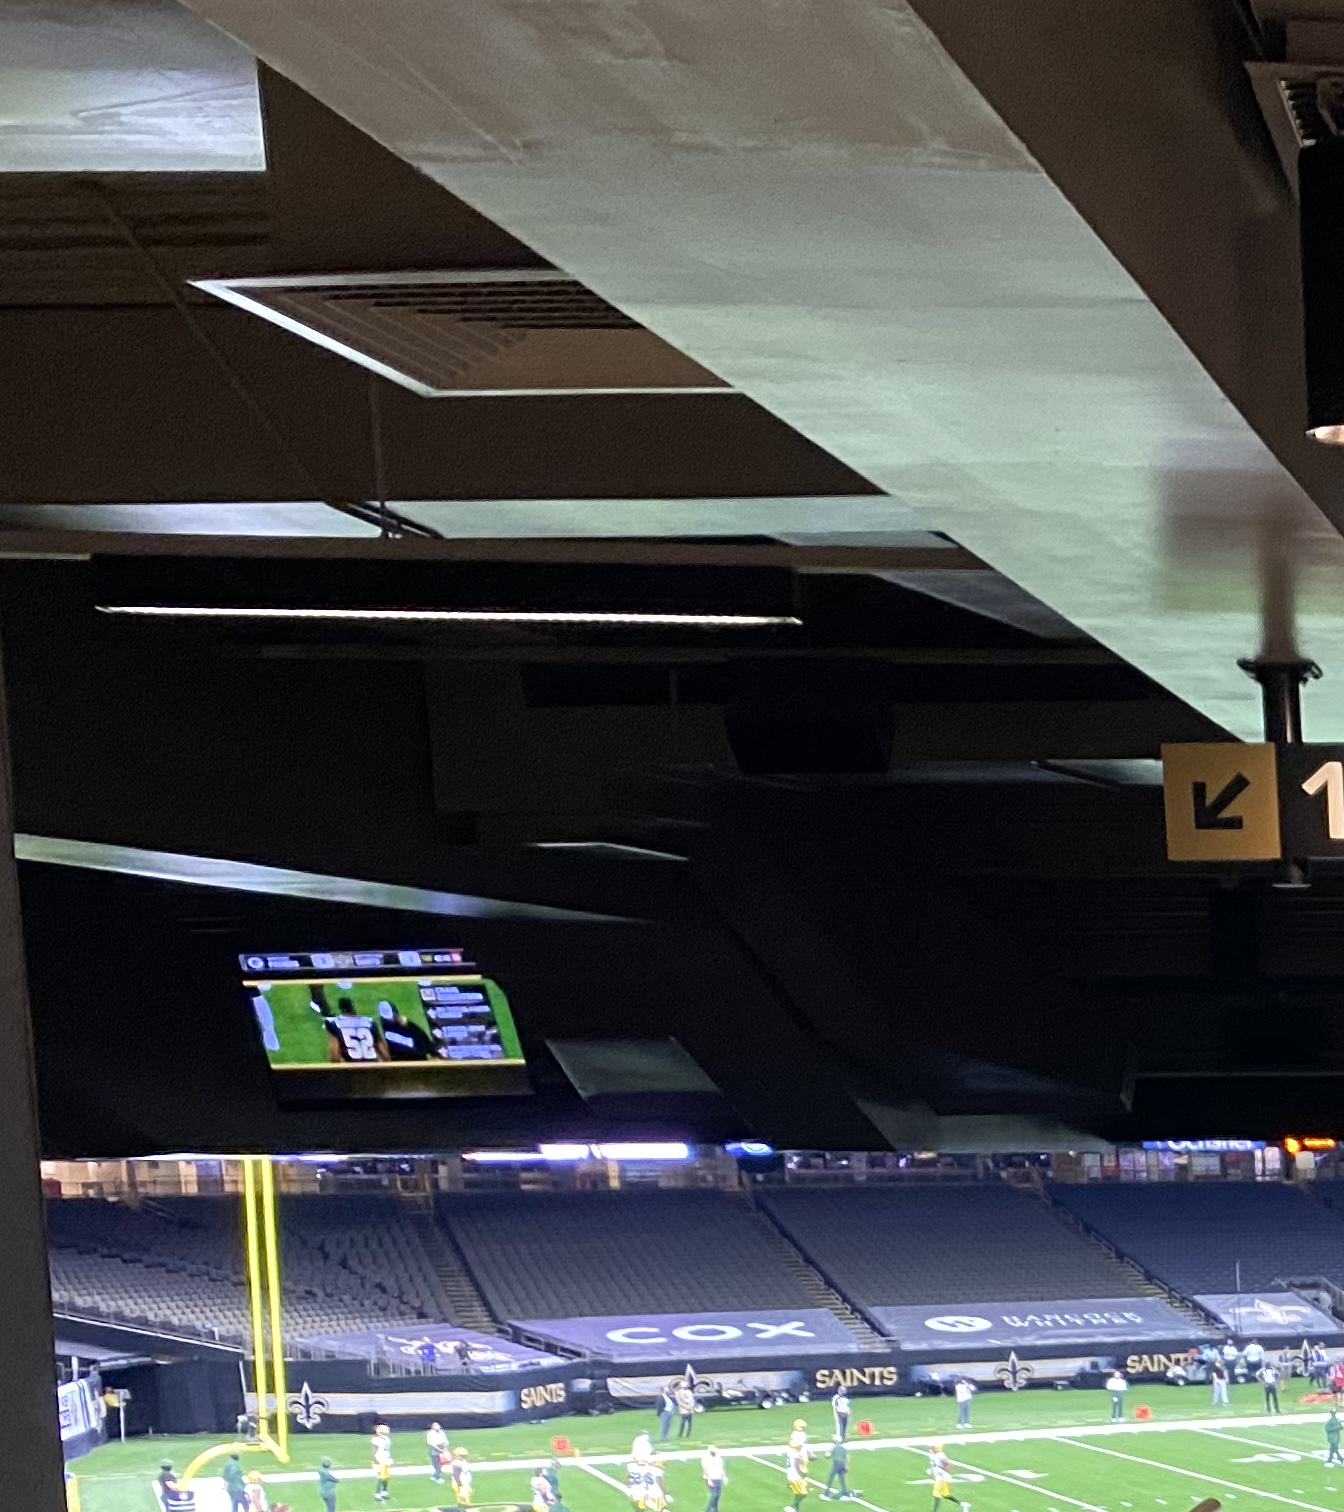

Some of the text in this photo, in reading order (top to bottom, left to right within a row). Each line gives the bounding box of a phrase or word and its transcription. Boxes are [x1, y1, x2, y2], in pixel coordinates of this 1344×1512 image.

[605, 1320, 816, 1344] COX
[815, 1366, 898, 1389] SAINTS
[520, 1383, 566, 1409] SAINTS
